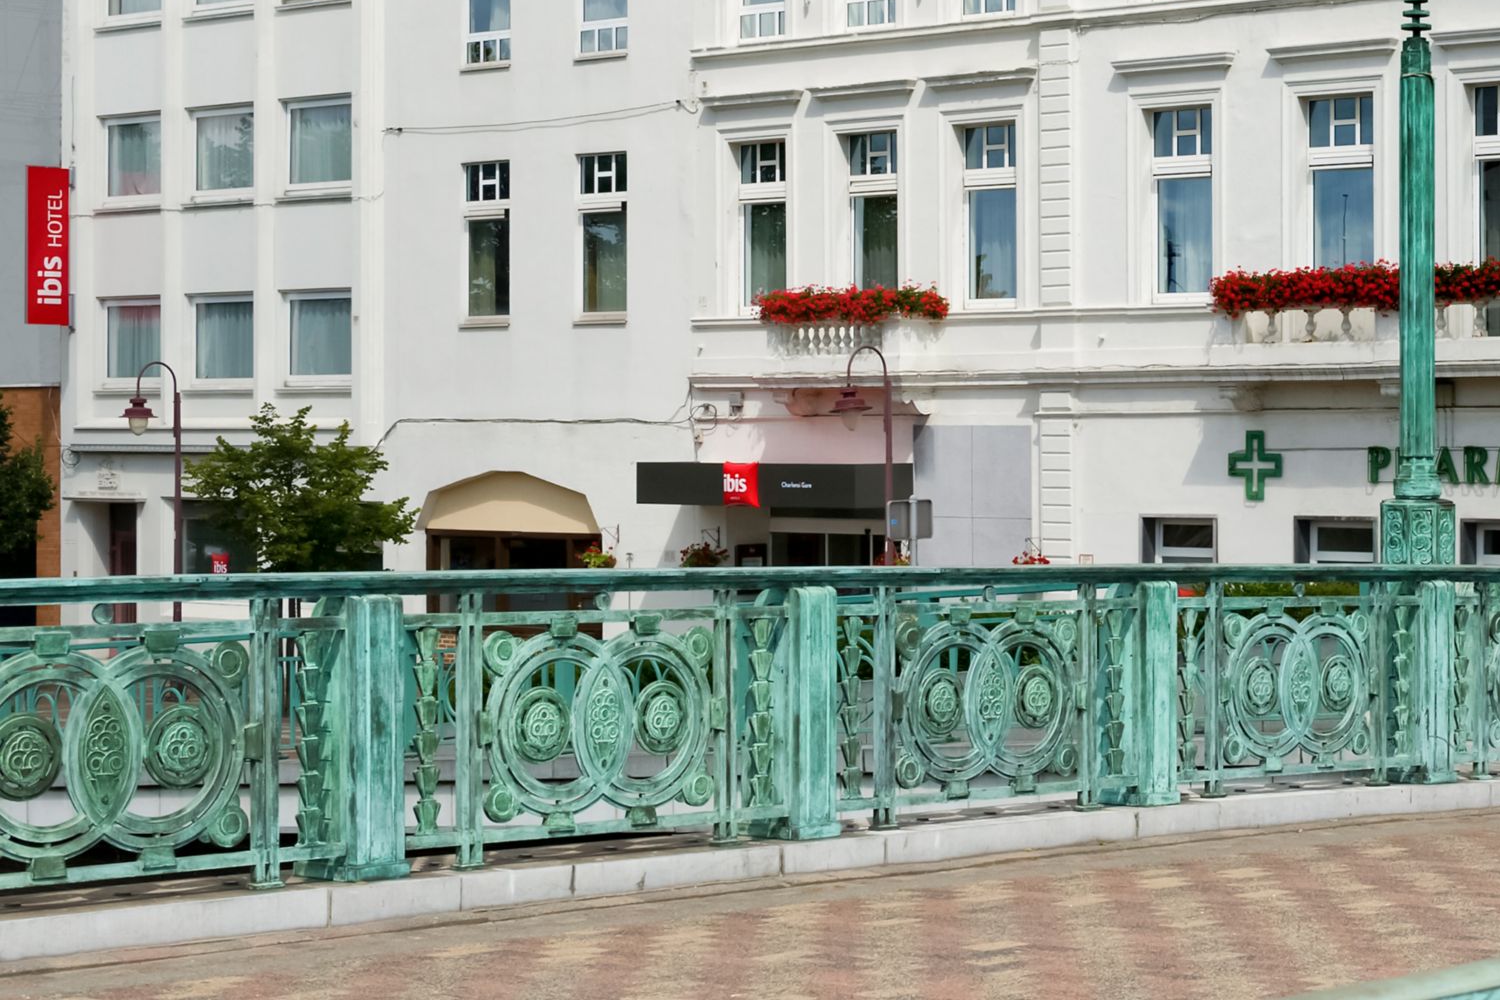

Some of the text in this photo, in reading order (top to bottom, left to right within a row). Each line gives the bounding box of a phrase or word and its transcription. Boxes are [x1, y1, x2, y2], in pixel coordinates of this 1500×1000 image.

[37, 189, 63, 305] ibis HOTEL
[723, 473, 748, 493] ibis
